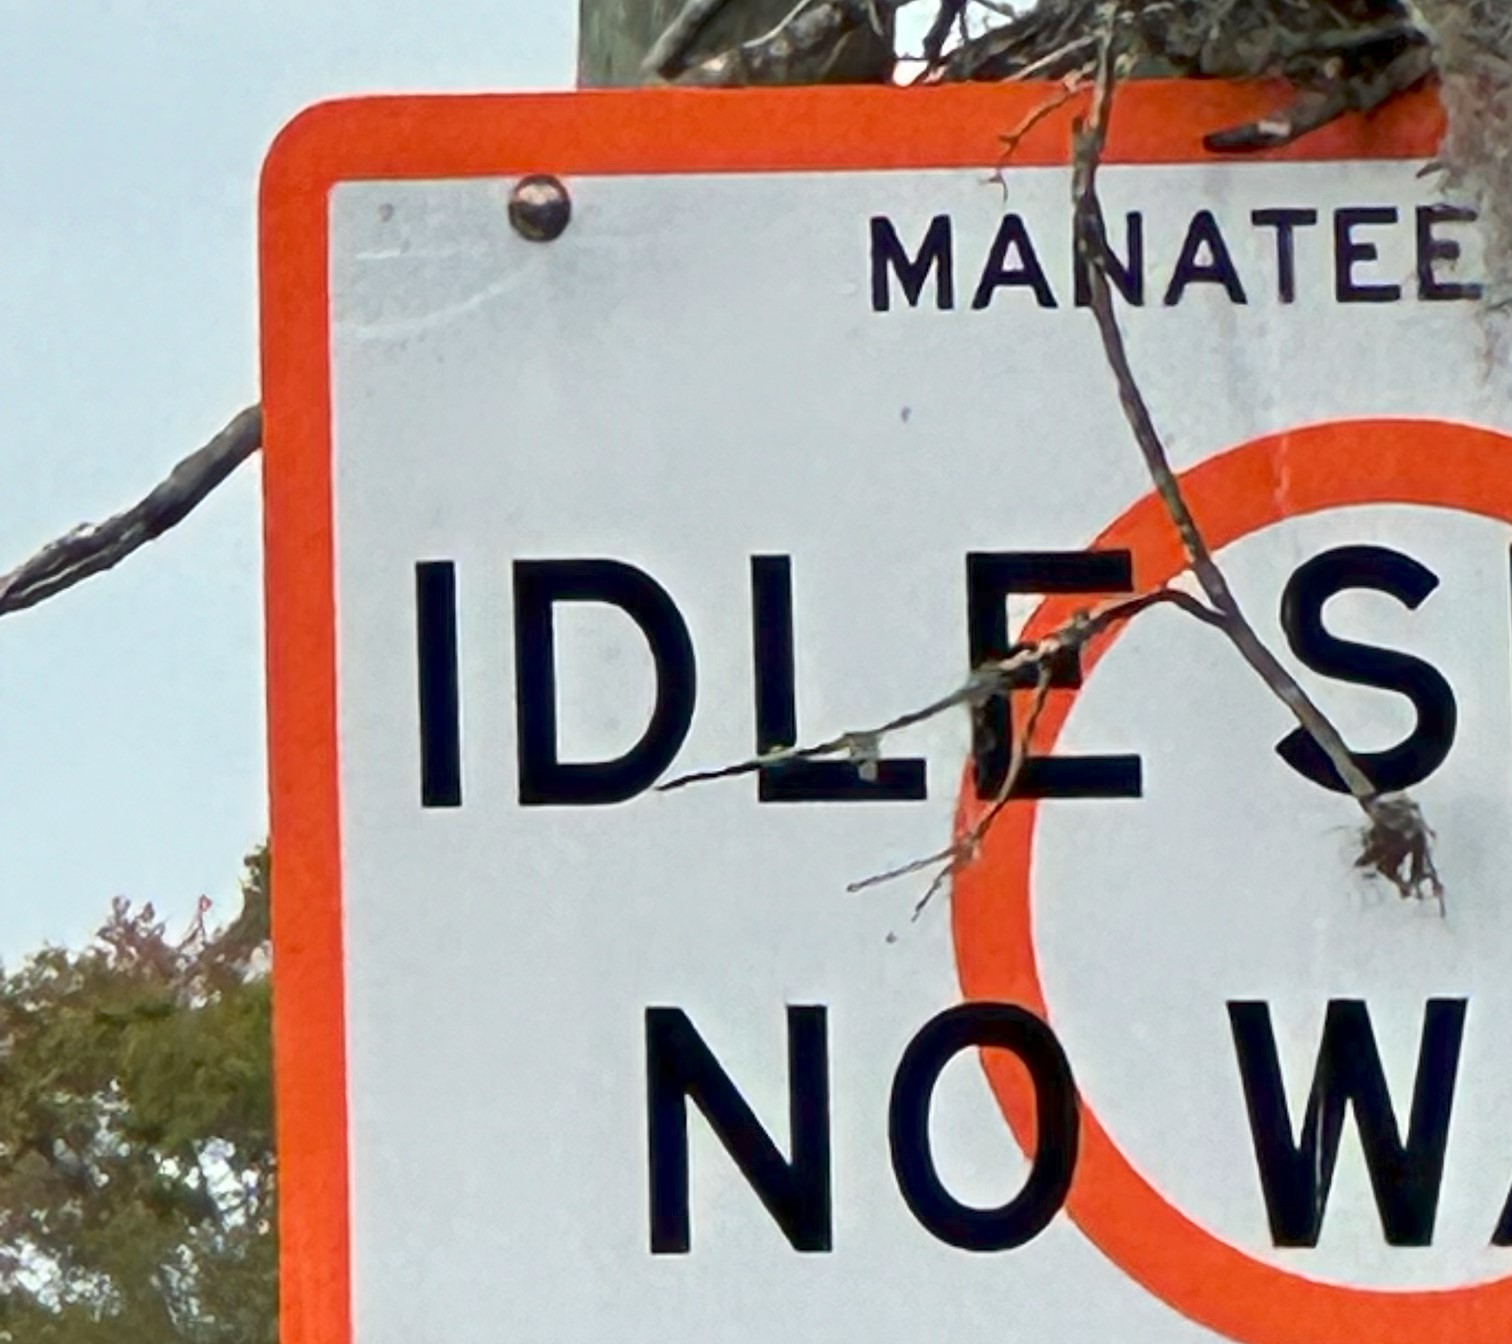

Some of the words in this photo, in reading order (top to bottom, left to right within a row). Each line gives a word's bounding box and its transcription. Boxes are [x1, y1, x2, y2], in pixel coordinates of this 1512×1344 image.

[870, 205, 1484, 312] MANATEE
[415, 550, 1143, 807] IDLE
[645, 1001, 1082, 1254] NO
